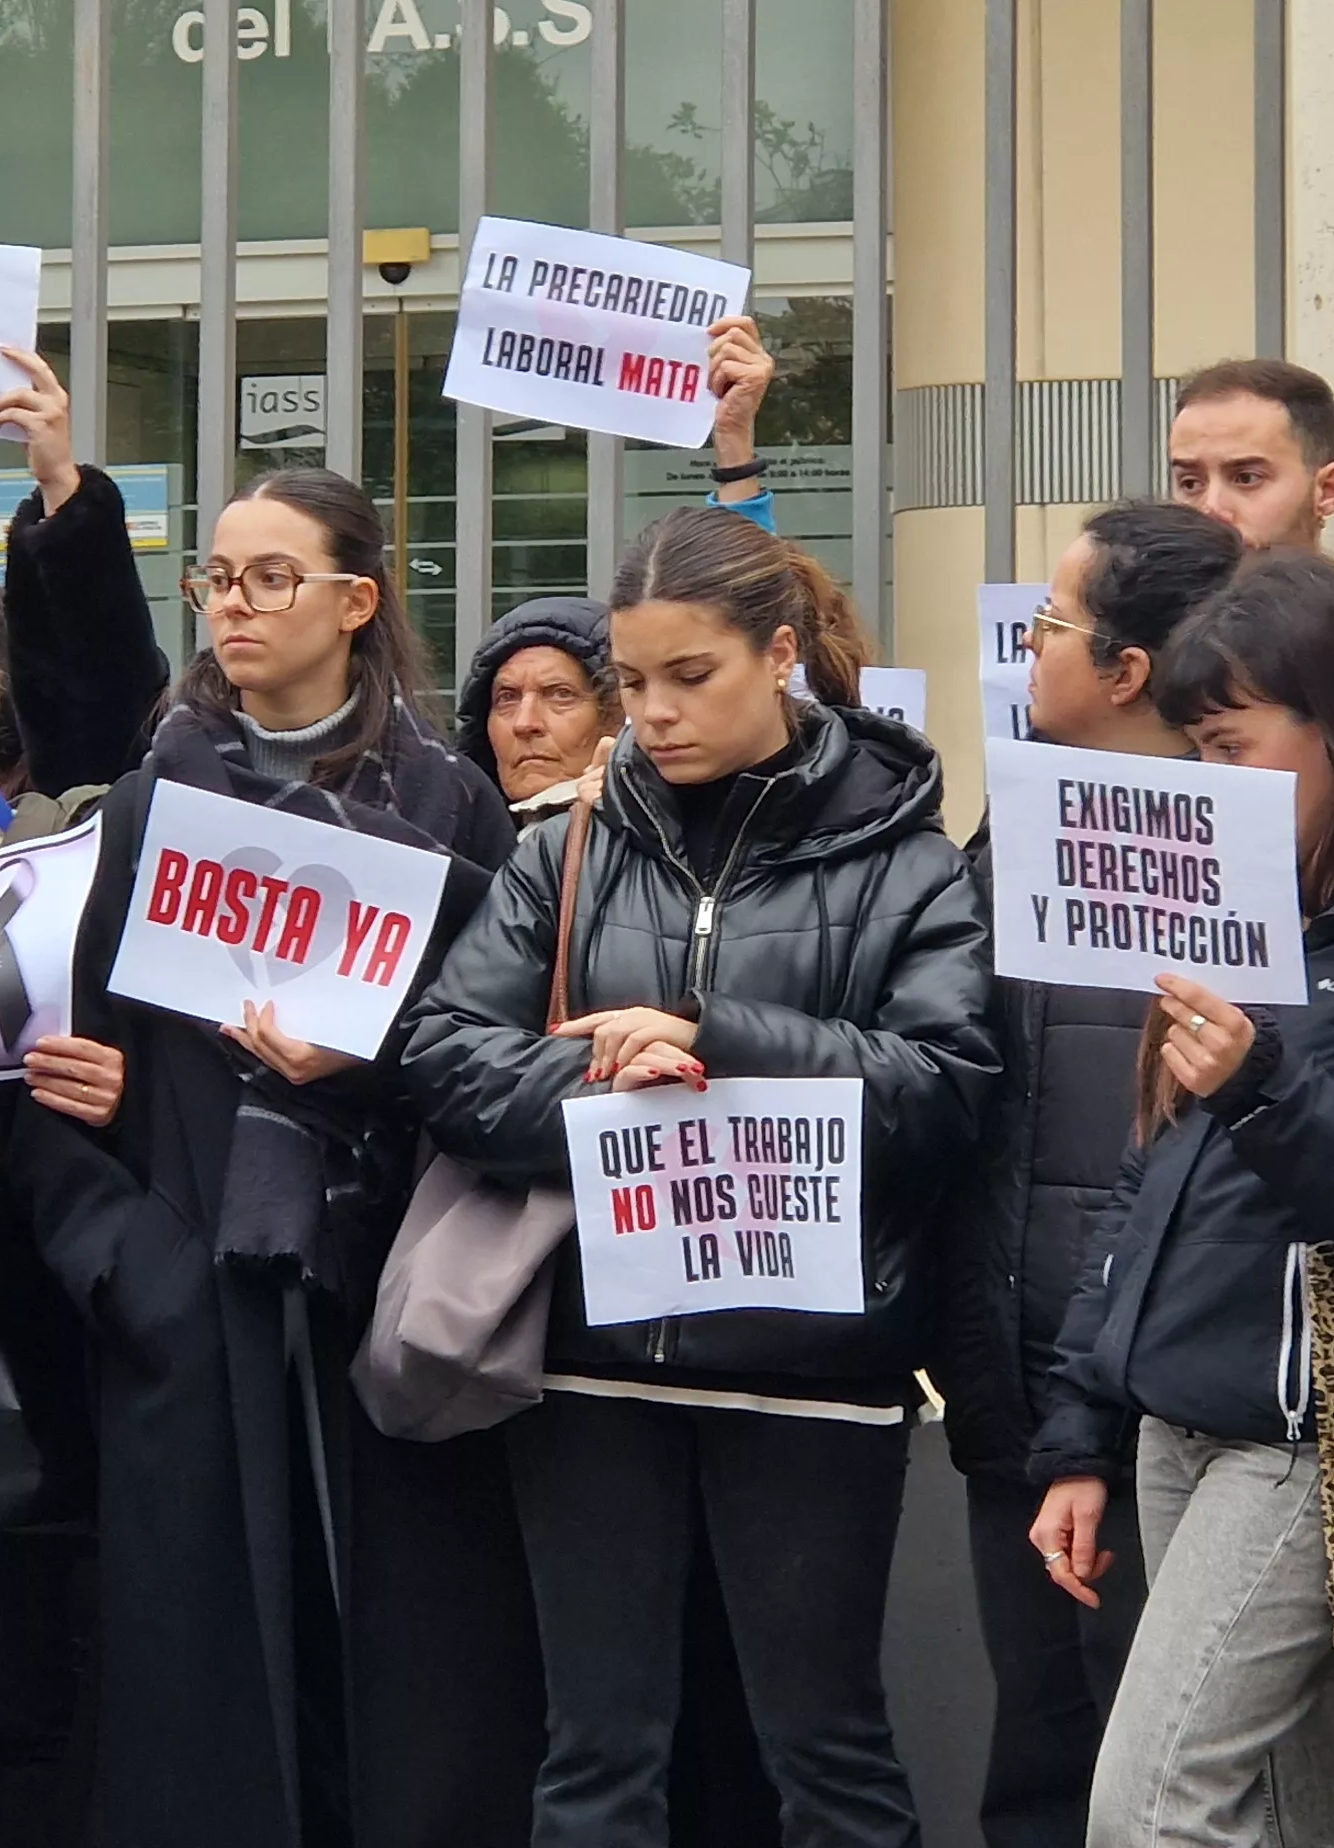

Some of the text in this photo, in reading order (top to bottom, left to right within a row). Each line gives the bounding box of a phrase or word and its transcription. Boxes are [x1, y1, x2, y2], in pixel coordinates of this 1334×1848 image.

[483, 252, 728, 327] LA PRECARIEDAD
[246, 382, 321, 413] iass
[481, 326, 701, 403] LABORAL MATA
[996, 622, 1027, 664] LA
[1057, 778, 1214, 846] EXIGIMOS
[1056, 837, 1221, 907] DERECHOS
[146, 848, 411, 987] BASTA YA
[1031, 894, 1270, 968] Y PROTECCIÓN
[599, 1116, 845, 1178] QUE EL TRABAJO
[611, 1173, 841, 1235] NO NOS CUESTE
[682, 1230, 795, 1282] LA VIDA
